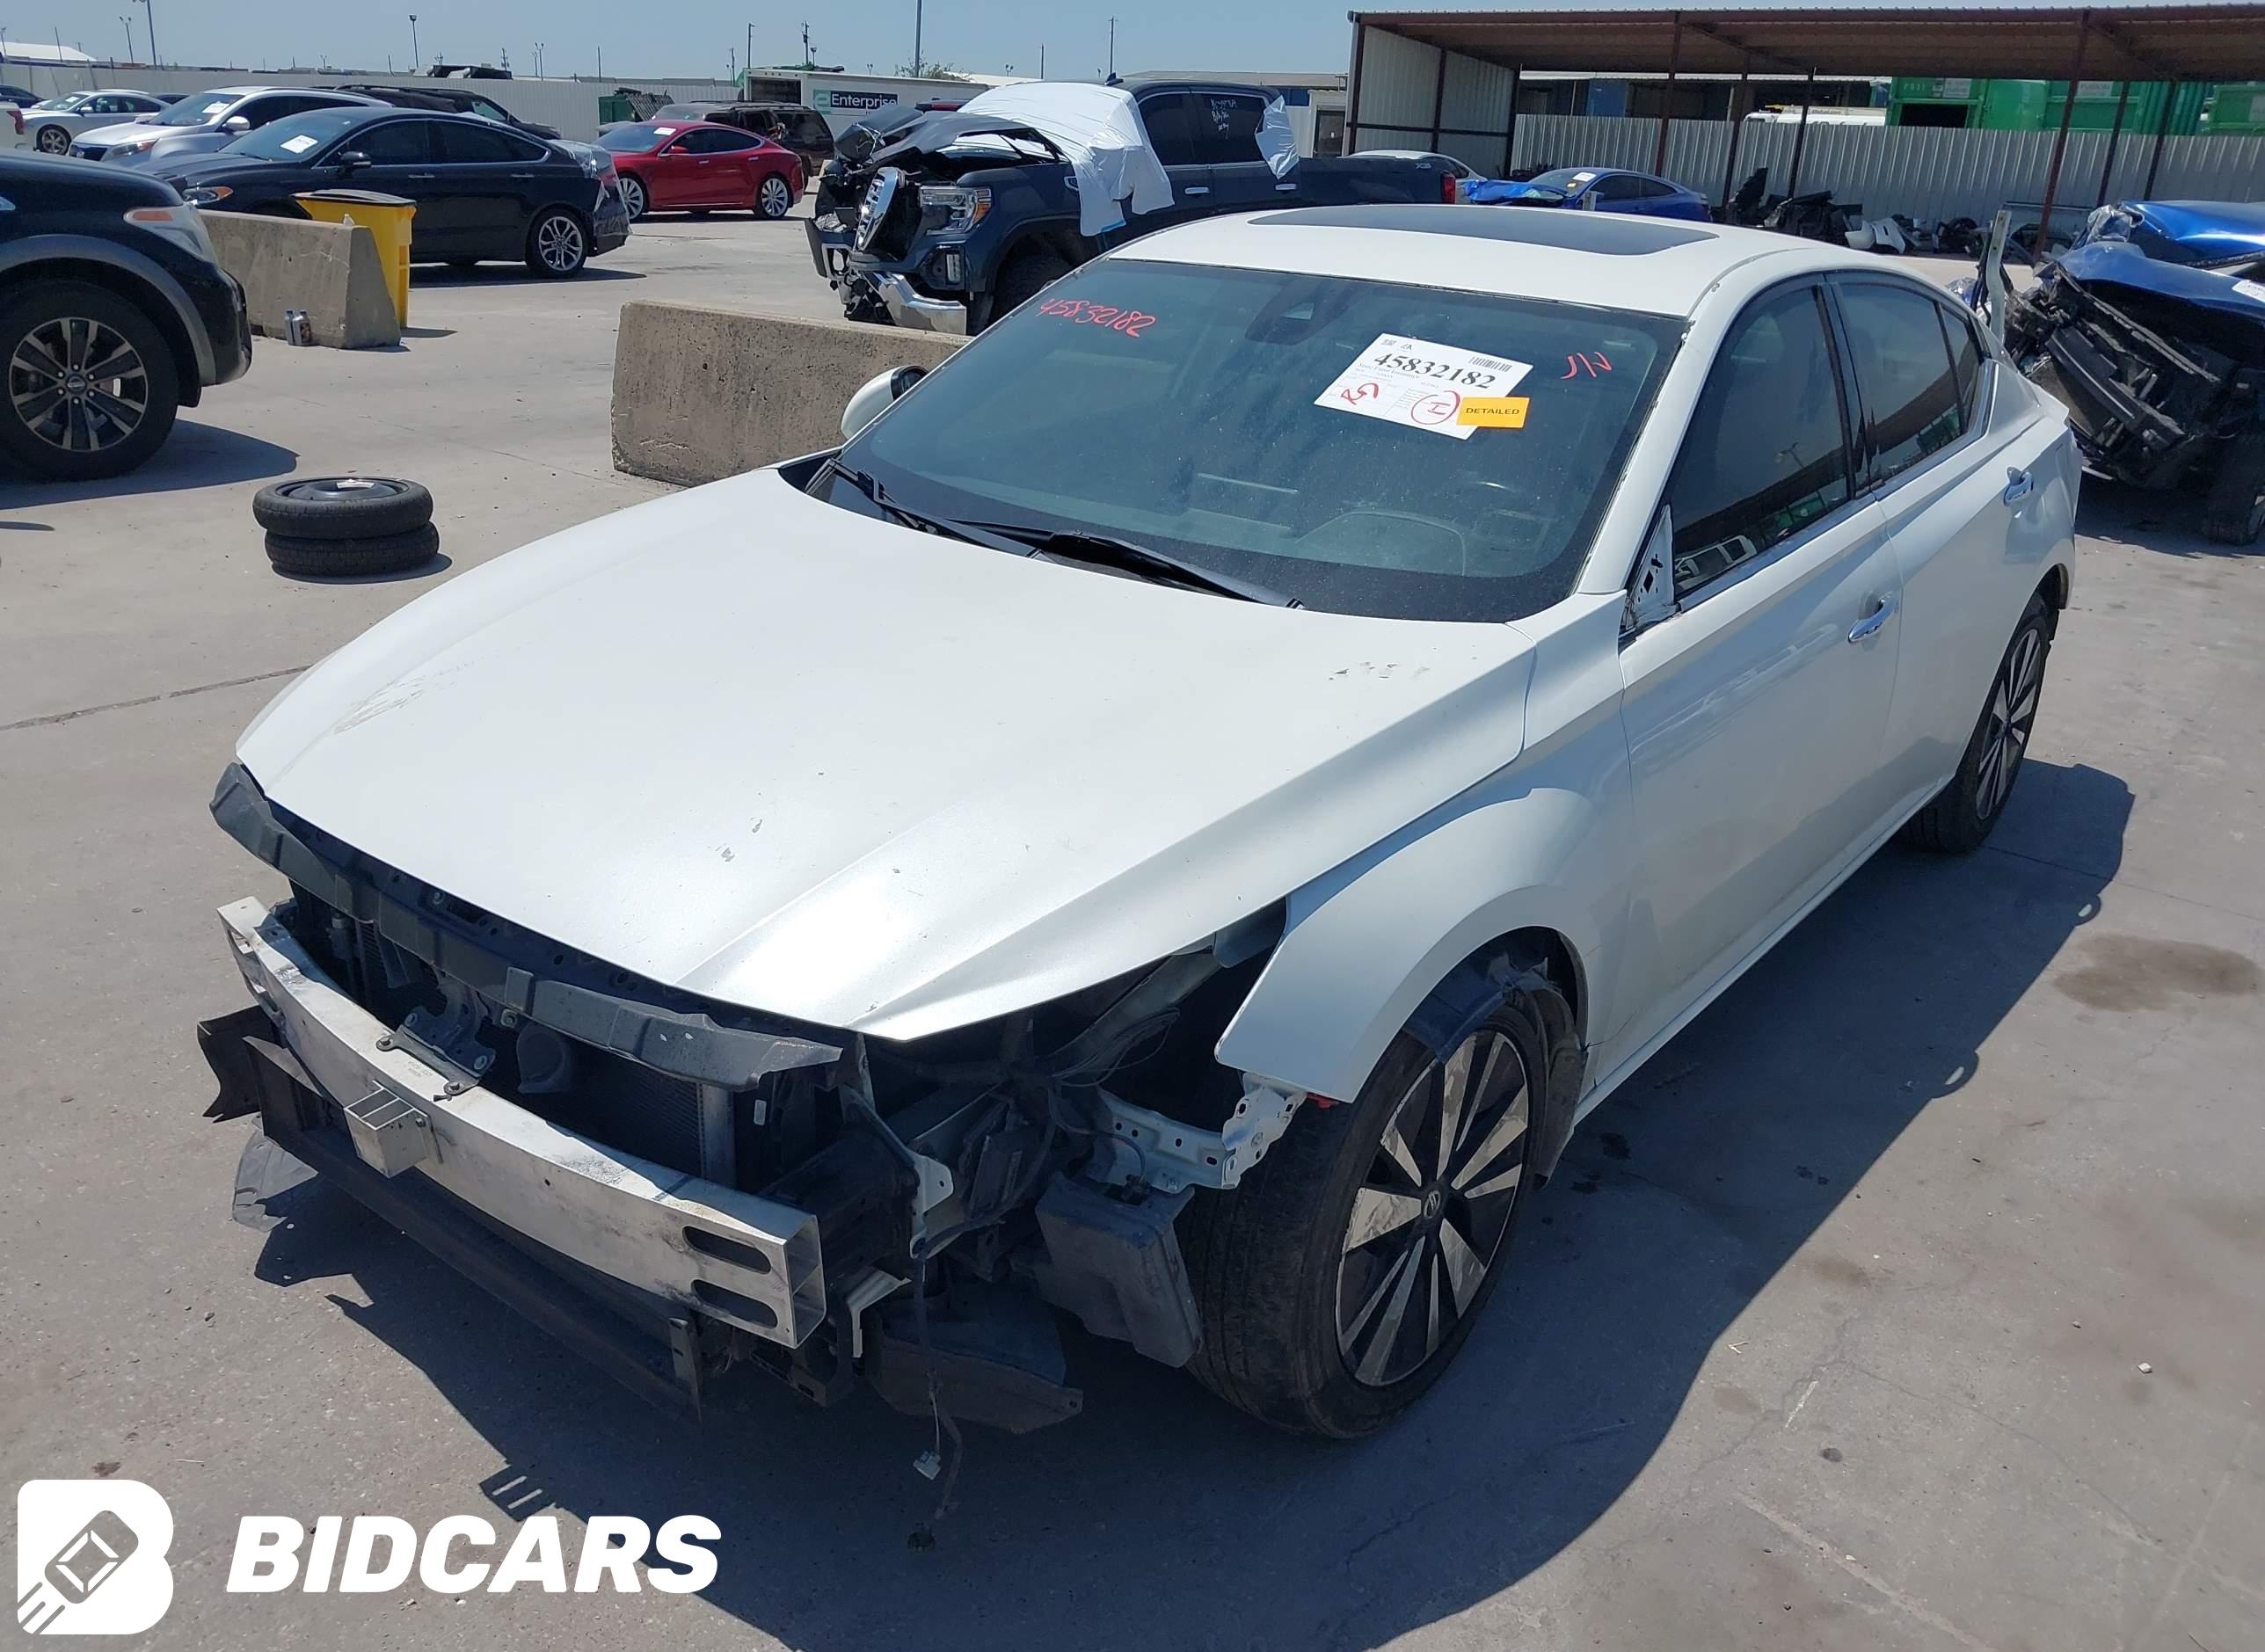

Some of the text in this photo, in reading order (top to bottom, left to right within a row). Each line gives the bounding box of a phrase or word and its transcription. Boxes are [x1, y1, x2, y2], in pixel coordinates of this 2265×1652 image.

[832, 92, 898, 109] Enterprise
[1035, 298, 1157, 338] 45832182
[1373, 353, 1497, 389] 45832182
[1465, 406, 1520, 416] DETAILED
